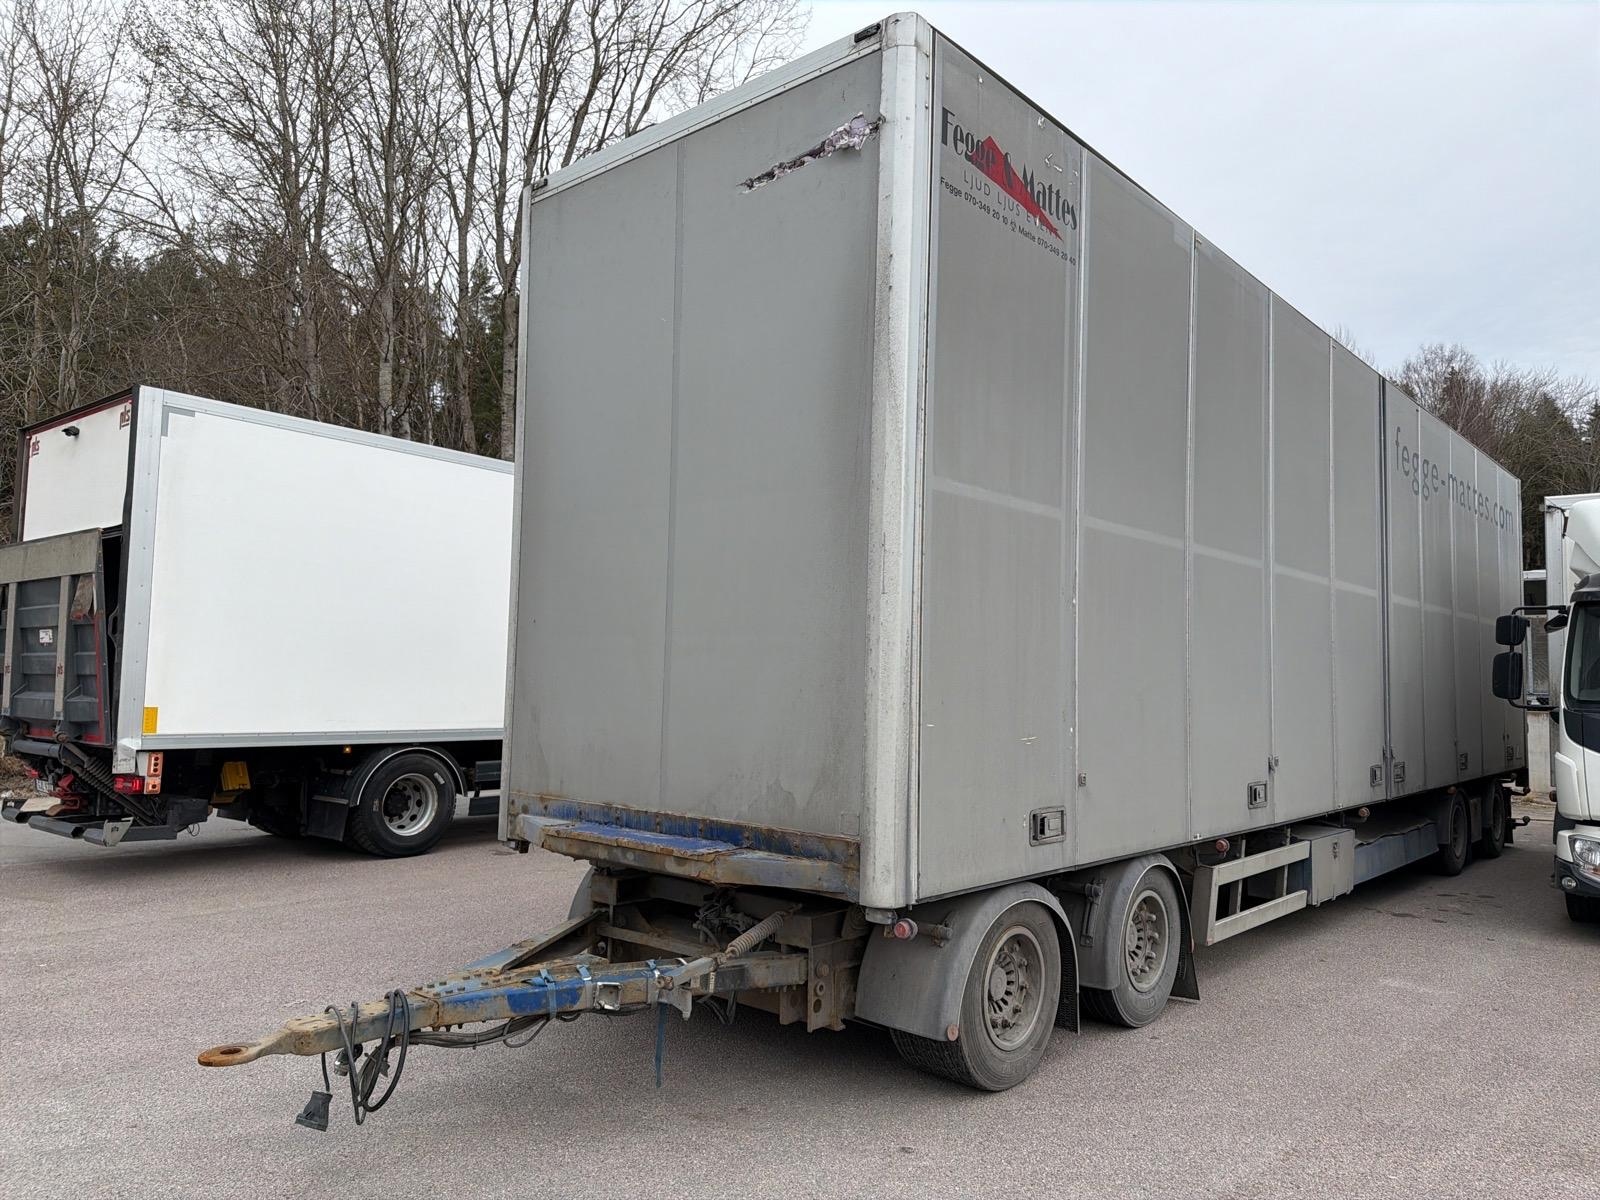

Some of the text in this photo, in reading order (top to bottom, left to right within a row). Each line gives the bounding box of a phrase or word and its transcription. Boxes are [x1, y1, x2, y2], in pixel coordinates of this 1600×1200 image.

[941, 106, 997, 172] Fegge
[1021, 163, 1077, 231] Mattes
[963, 169, 991, 197] LJUD
[997, 191, 1021, 217] LJUS
[940, 176, 962, 198] Fegge
[964, 191, 991, 215] 070-349
[992, 209, 1001, 221] 20
[1002, 215, 1009, 225] 10
[1018, 225, 1036, 243] Matte
[1037, 237, 1060, 257] 070-349
[1395, 426, 1514, 535] fegge-mattes.com
